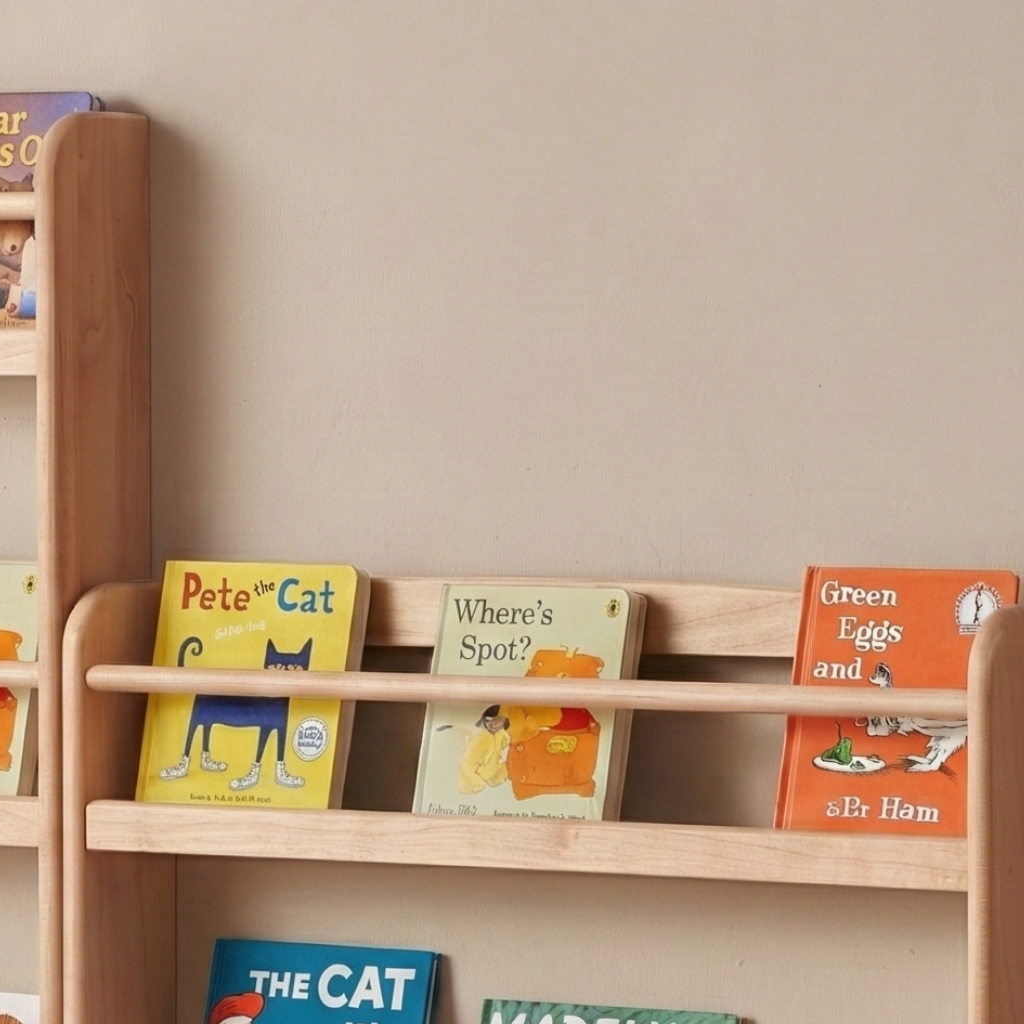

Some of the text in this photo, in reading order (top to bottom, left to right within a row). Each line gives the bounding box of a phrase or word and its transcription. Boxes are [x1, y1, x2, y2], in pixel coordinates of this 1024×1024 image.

[19, 134, 44, 166] O
[181, 572, 335, 614] Pete the Cat
[820, 580, 898, 607] Green
[454, 598, 554, 626] Where's
[459, 634, 532, 666] Spot?
[837, 616, 904, 652] Eggs
[813, 657, 863, 680] and
[878, 796, 940, 823] Ham
[249, 964, 416, 1011] THE CAT
